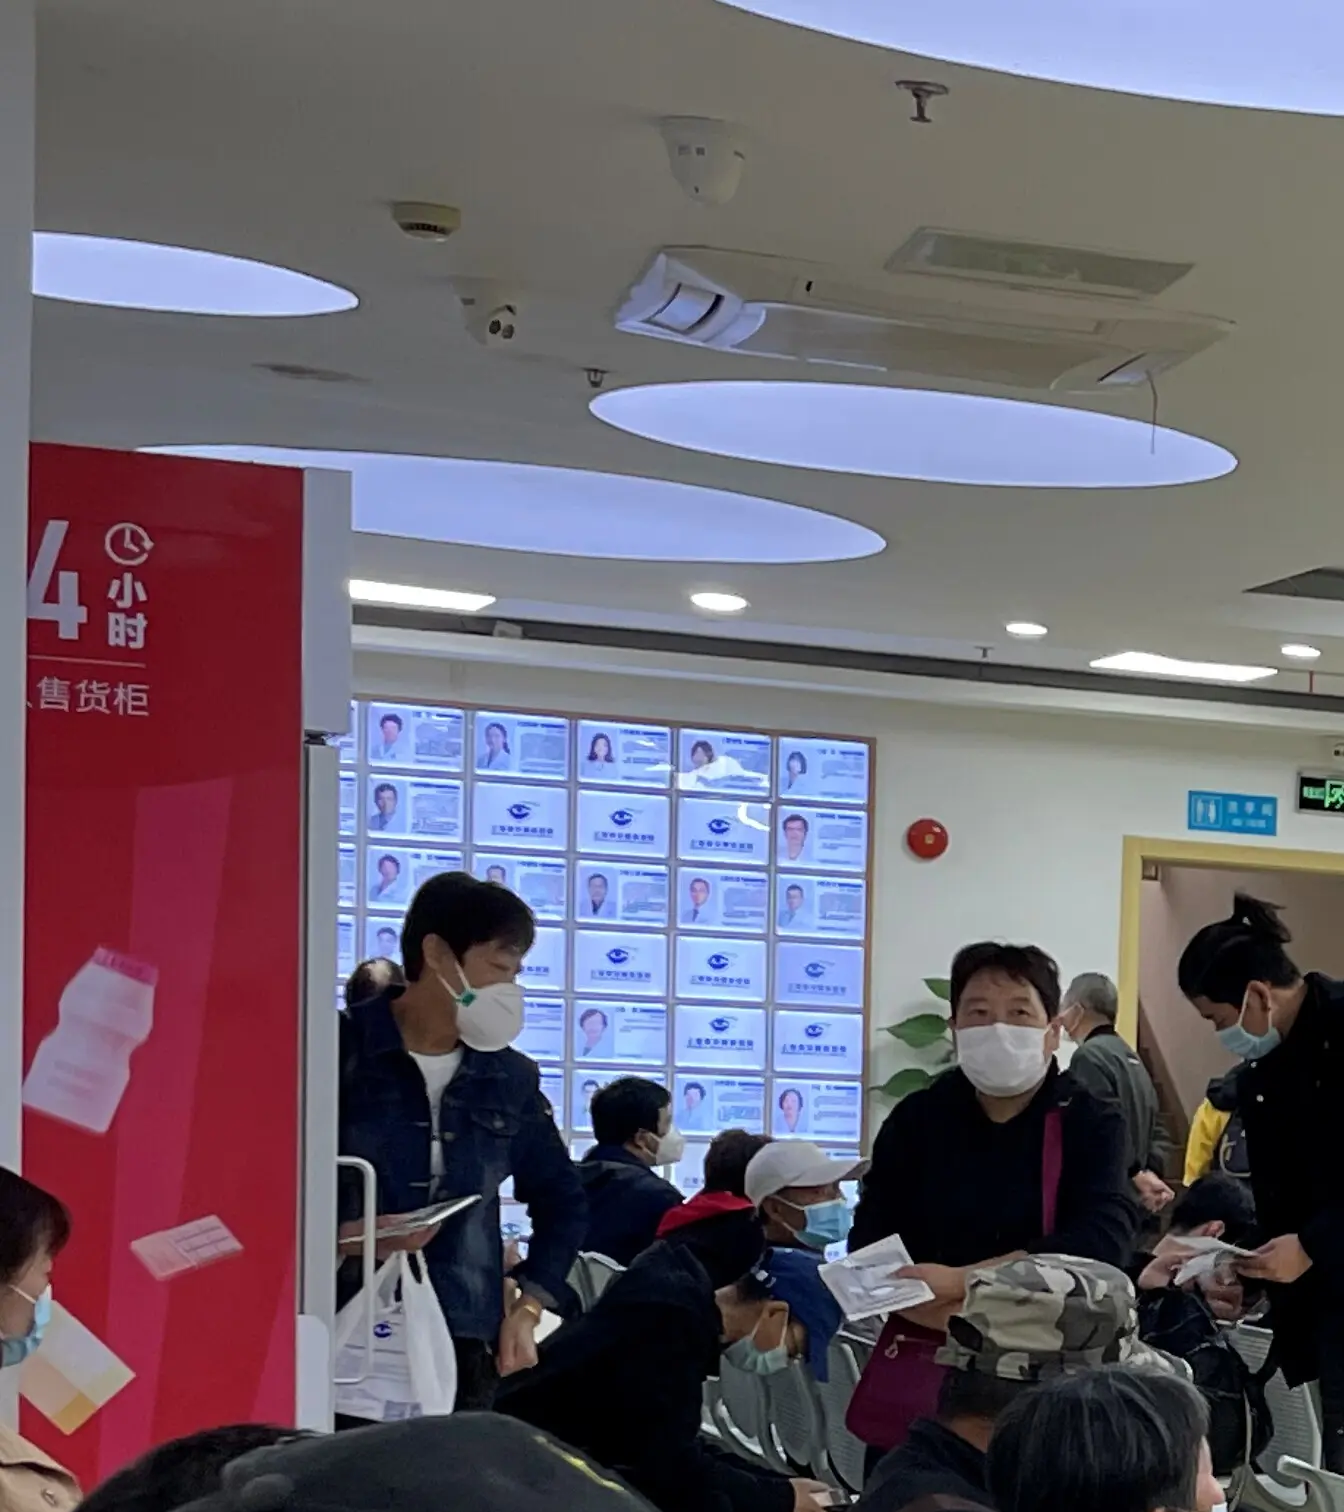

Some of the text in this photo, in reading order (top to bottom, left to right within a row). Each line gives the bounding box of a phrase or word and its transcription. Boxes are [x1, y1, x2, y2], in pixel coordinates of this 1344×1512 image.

[107, 572, 148, 649] 小时
[27, 675, 150, 716] 售货柜
